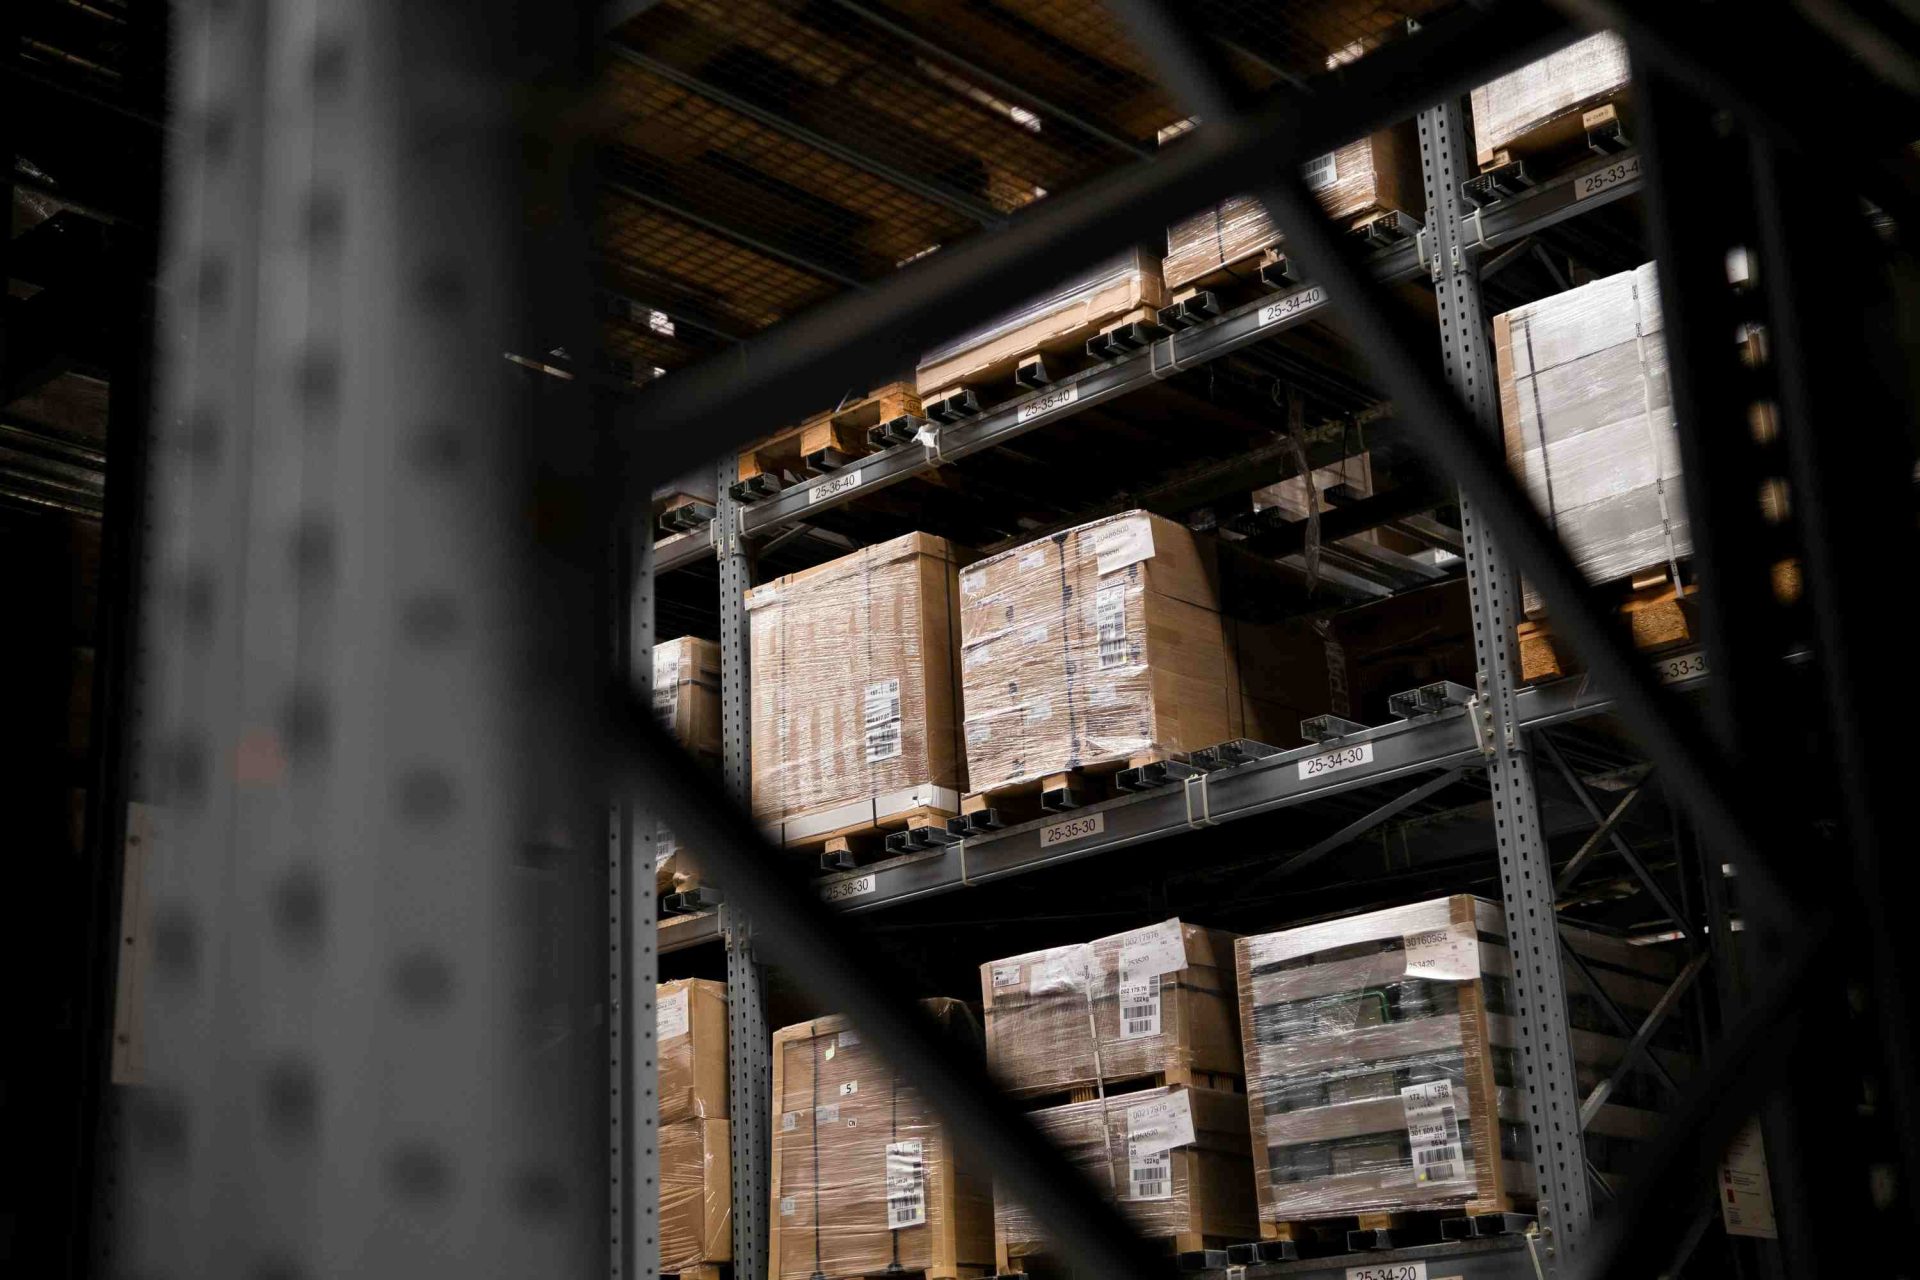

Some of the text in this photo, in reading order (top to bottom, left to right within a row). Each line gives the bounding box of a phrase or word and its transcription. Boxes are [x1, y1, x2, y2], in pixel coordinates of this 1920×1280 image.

[1585, 159, 1640, 192] 25-33-4
[1267, 288, 1319, 320] 25-34-40
[1025, 389, 1070, 416] 25-35-40
[815, 474, 854, 499] 25-36-40
[1308, 747, 1363, 774] 25-34-30
[1048, 818, 1096, 842] 25-35-30
[826, 878, 868, 900] 25-36-30
[1356, 1266, 1417, 1280] 25-34-20
